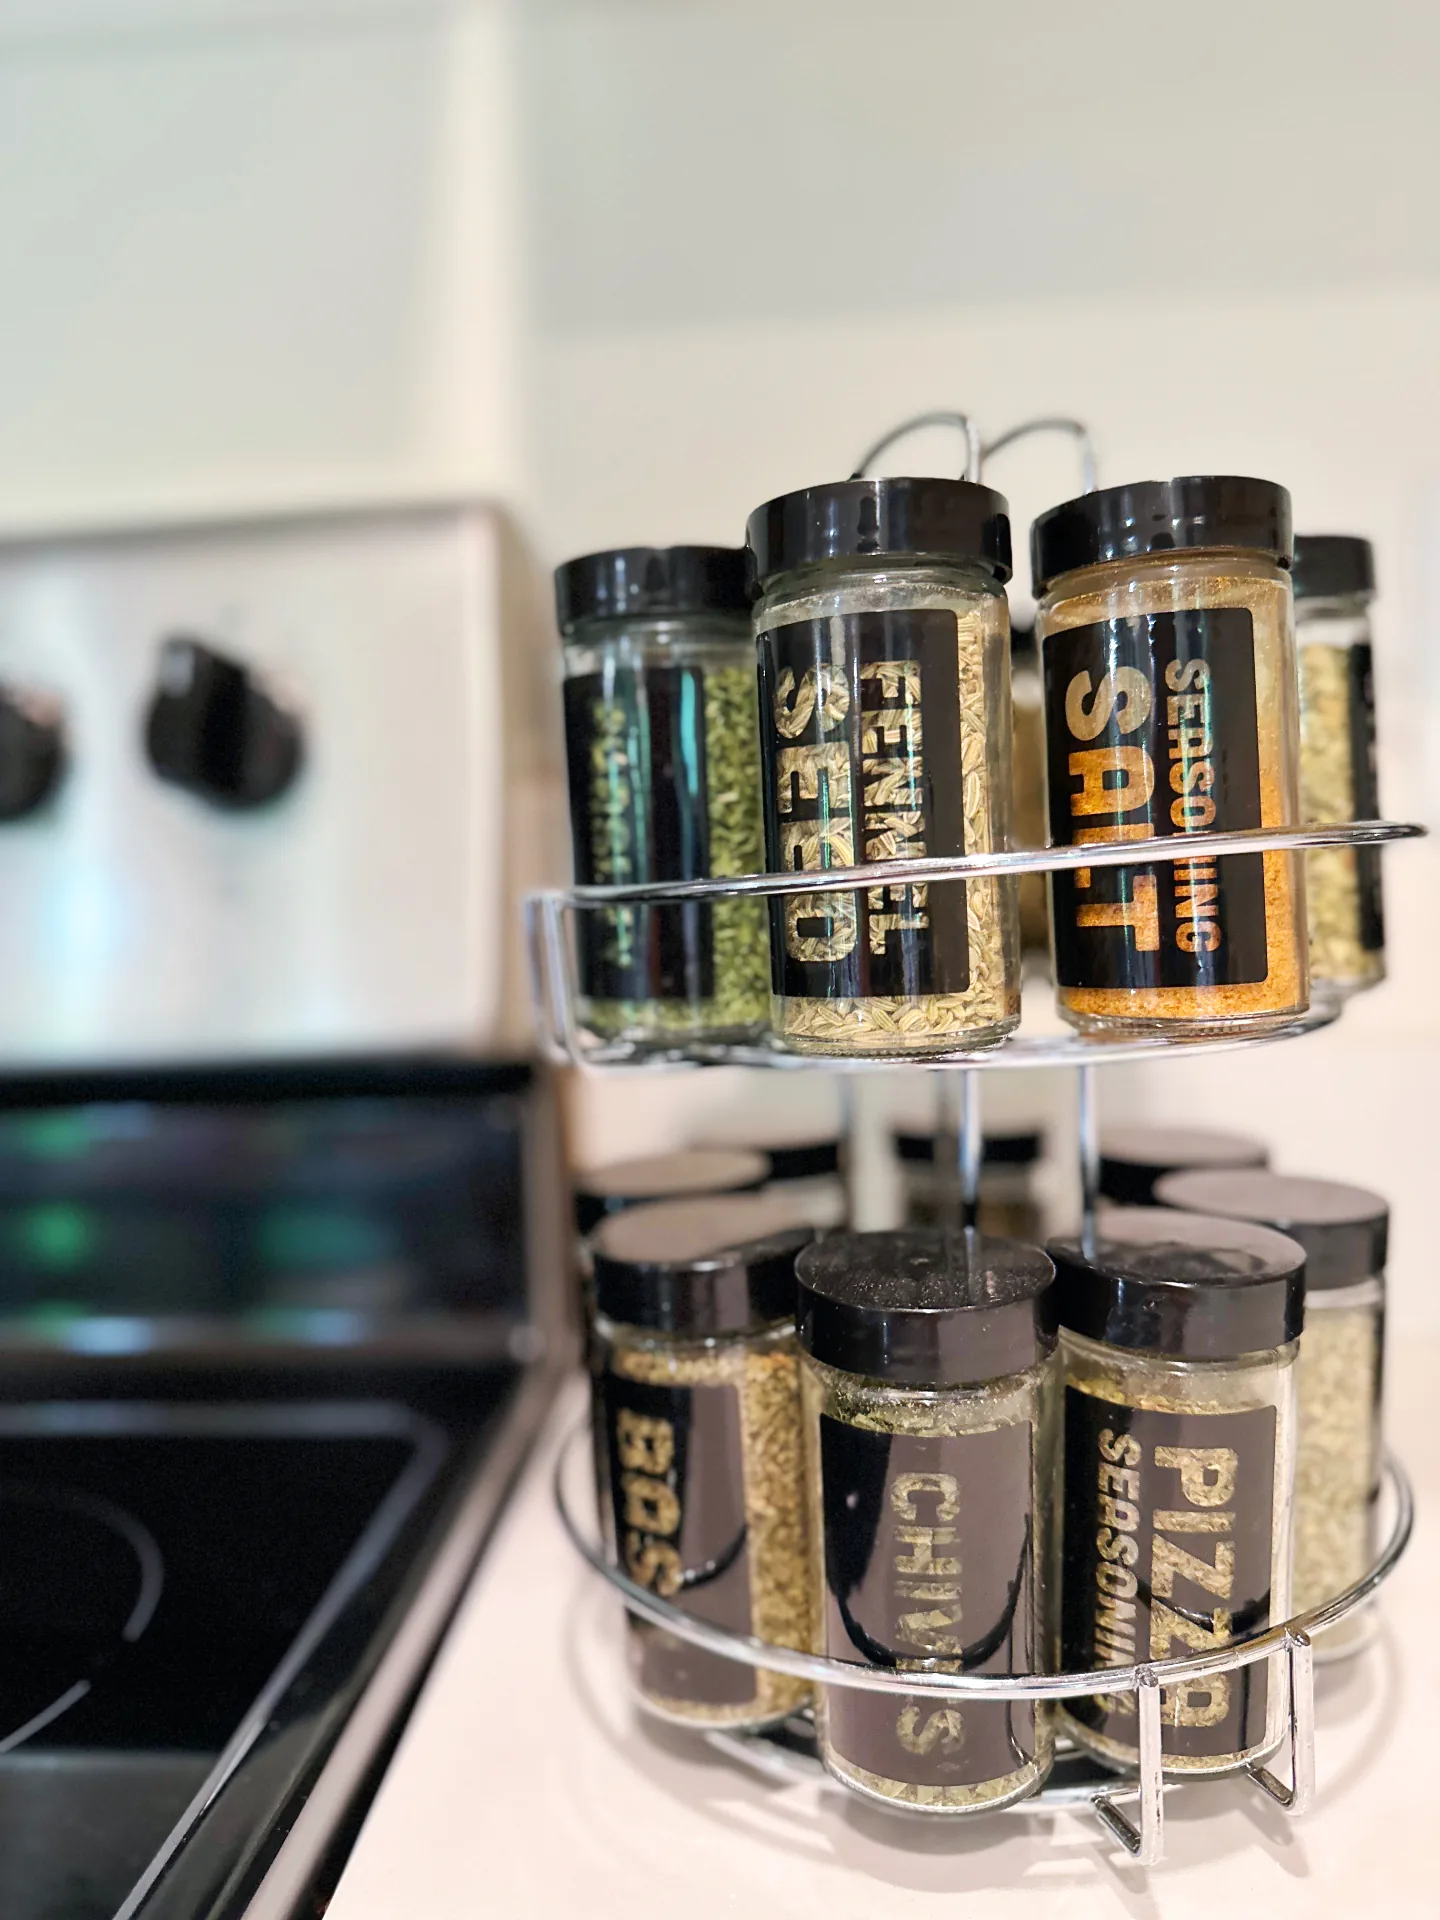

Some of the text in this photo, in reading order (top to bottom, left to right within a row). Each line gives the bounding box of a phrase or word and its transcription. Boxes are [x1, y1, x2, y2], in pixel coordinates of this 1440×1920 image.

[774, 663, 857, 962] SEED
[860, 660, 930, 955] FENNEL
[1065, 666, 1160, 952] SALT
[1149, 1445, 1239, 1727] PIZZA
